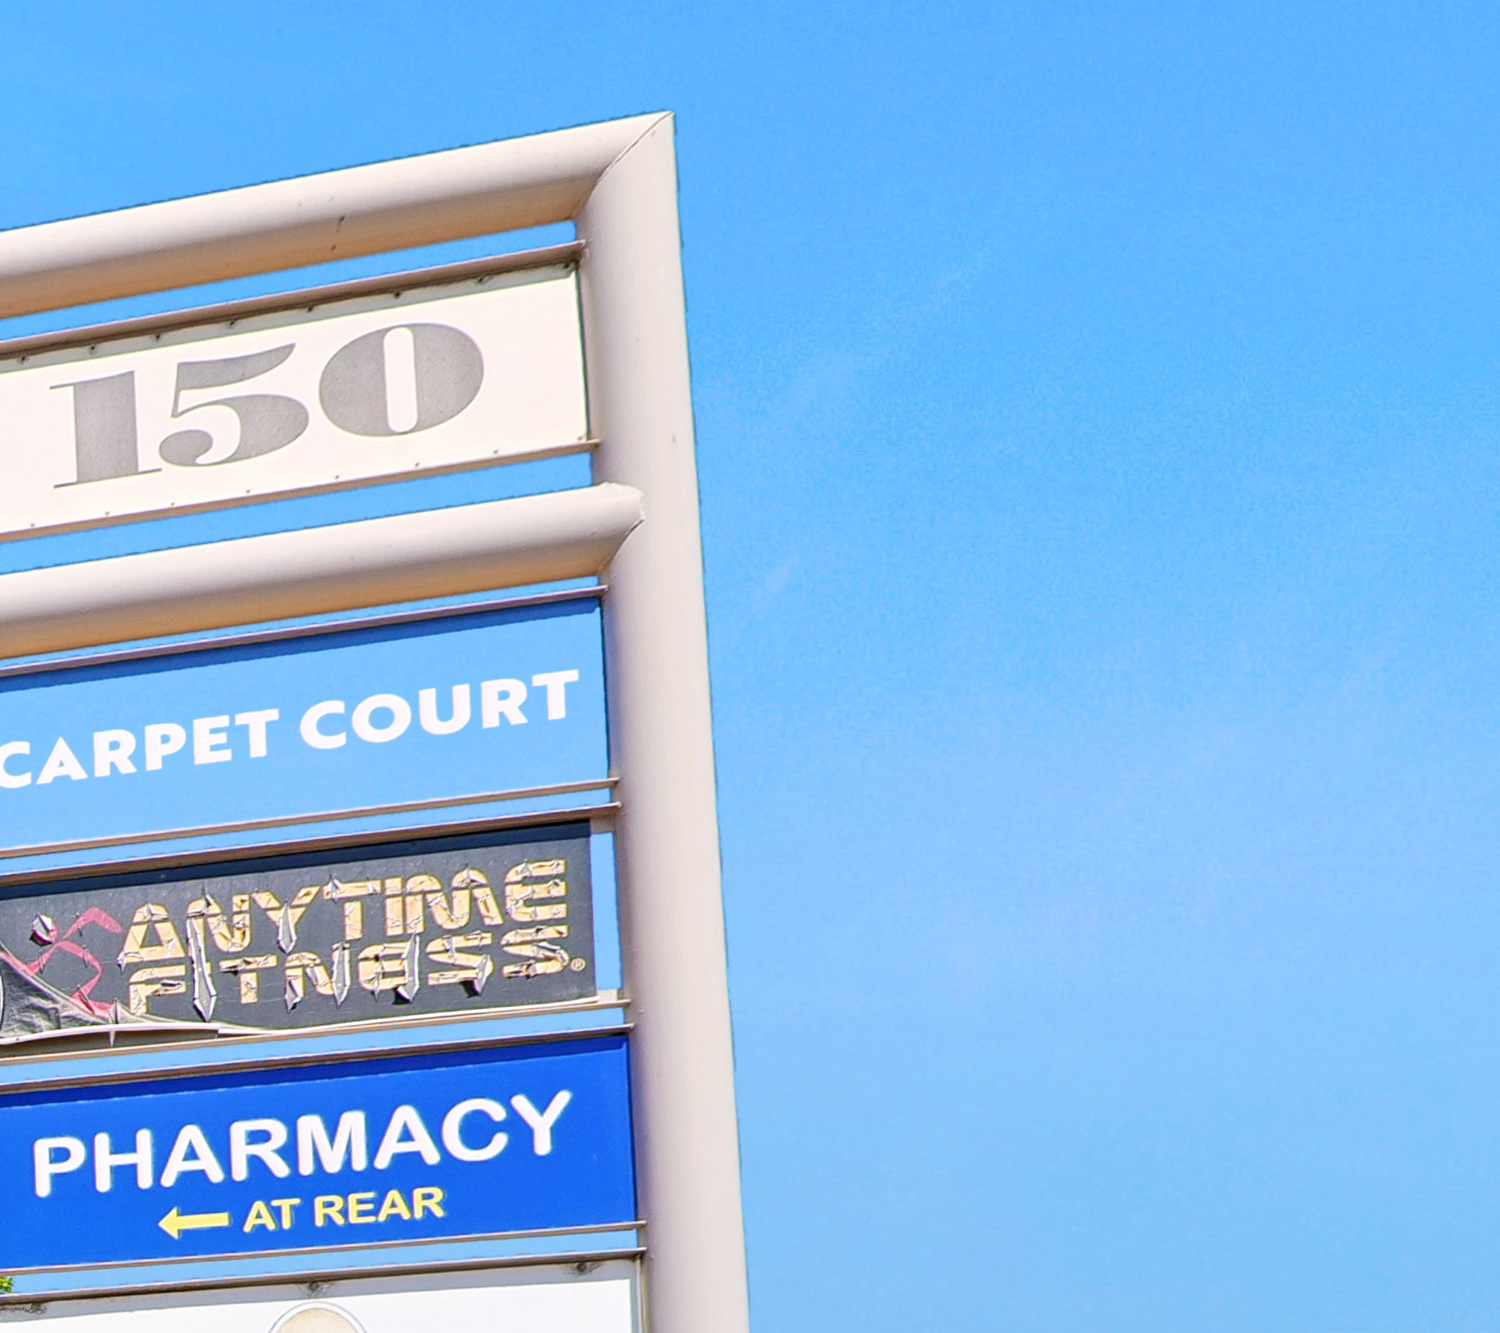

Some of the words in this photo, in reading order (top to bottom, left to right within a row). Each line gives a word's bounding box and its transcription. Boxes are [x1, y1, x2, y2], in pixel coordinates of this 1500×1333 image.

[48, 322, 485, 489] 150
[299, 669, 580, 751] COURT
[117, 858, 567, 966] ANYTIME
[31, 1090, 573, 1199] PHARMACY
[242, 1199, 301, 1233] AT
[313, 1186, 446, 1228] REAR
